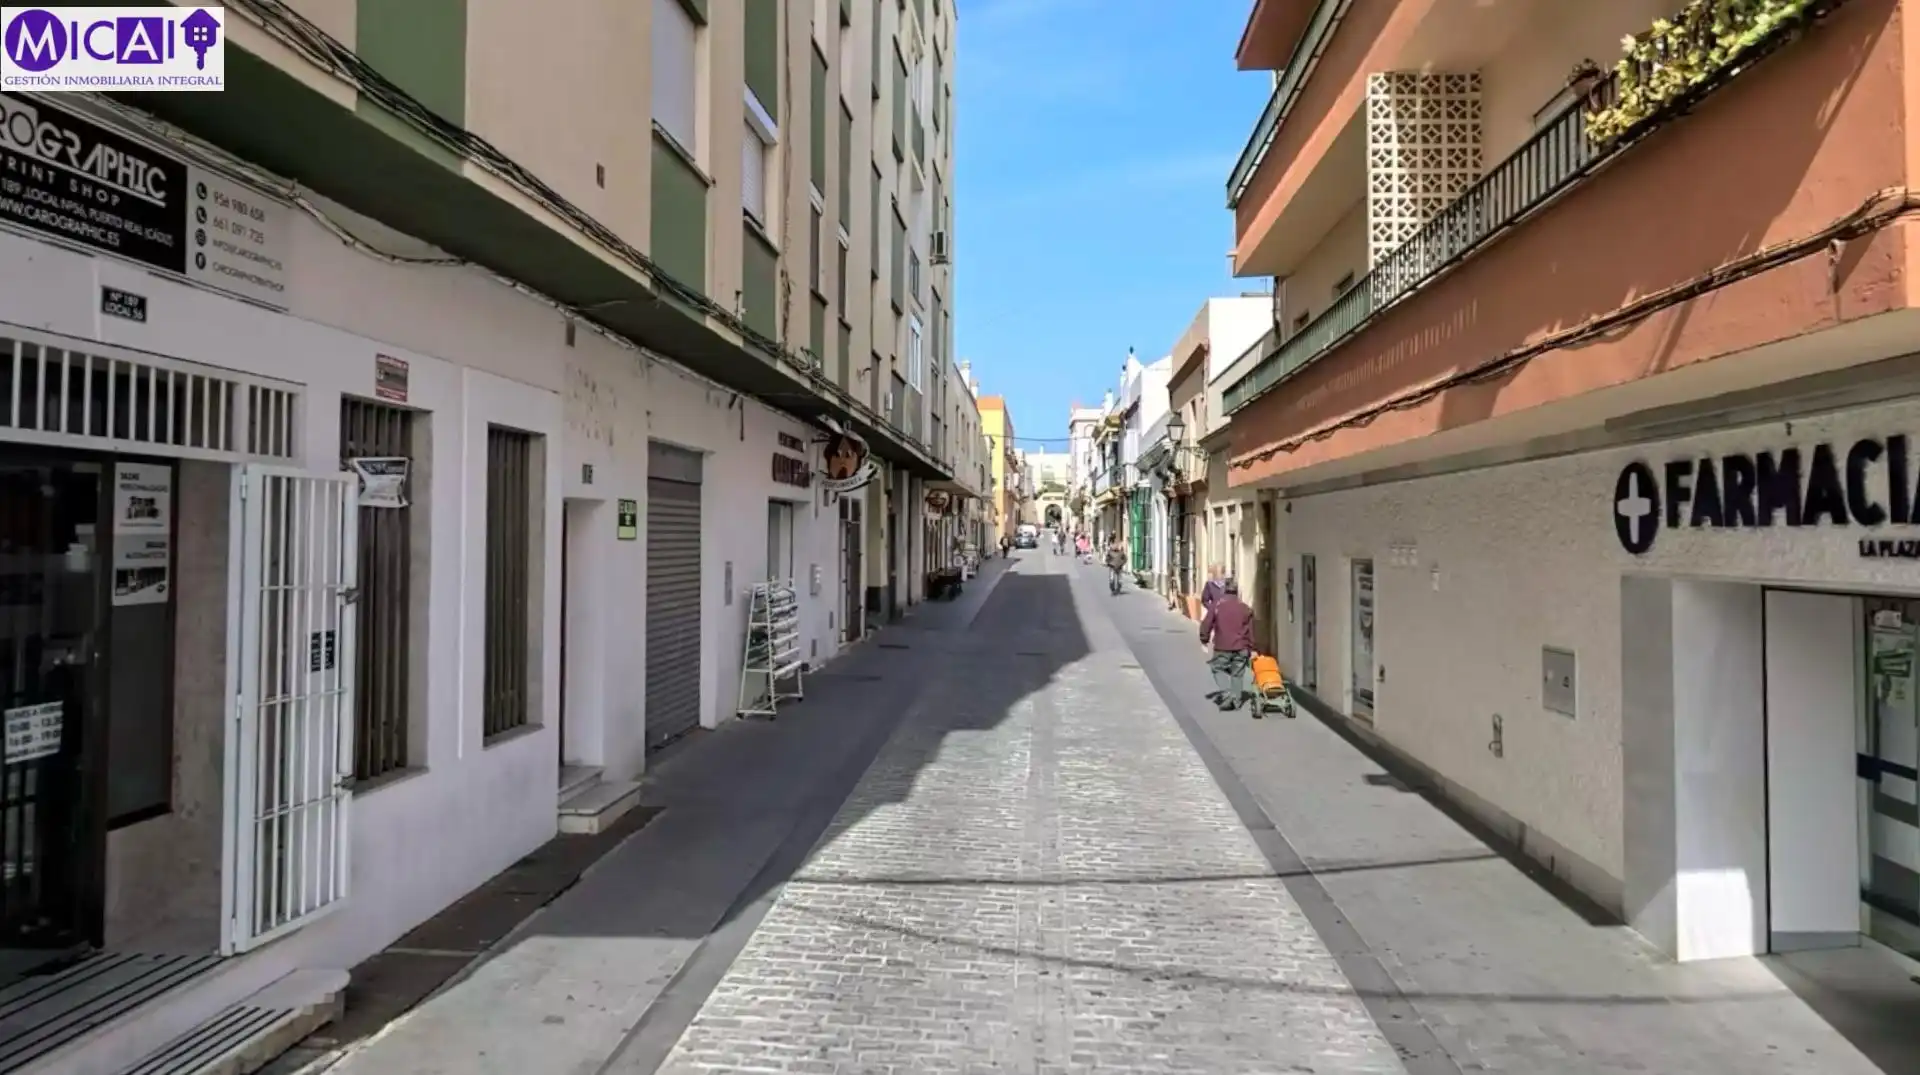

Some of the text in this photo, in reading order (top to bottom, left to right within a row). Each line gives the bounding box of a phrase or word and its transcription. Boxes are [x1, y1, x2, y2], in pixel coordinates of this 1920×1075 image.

[0, 152, 121, 207] RINT SHOP
[105, 302, 132, 317] LOCAL
[1665, 436, 1920, 528] FARMACI
[1858, 539, 1877, 557] LA
